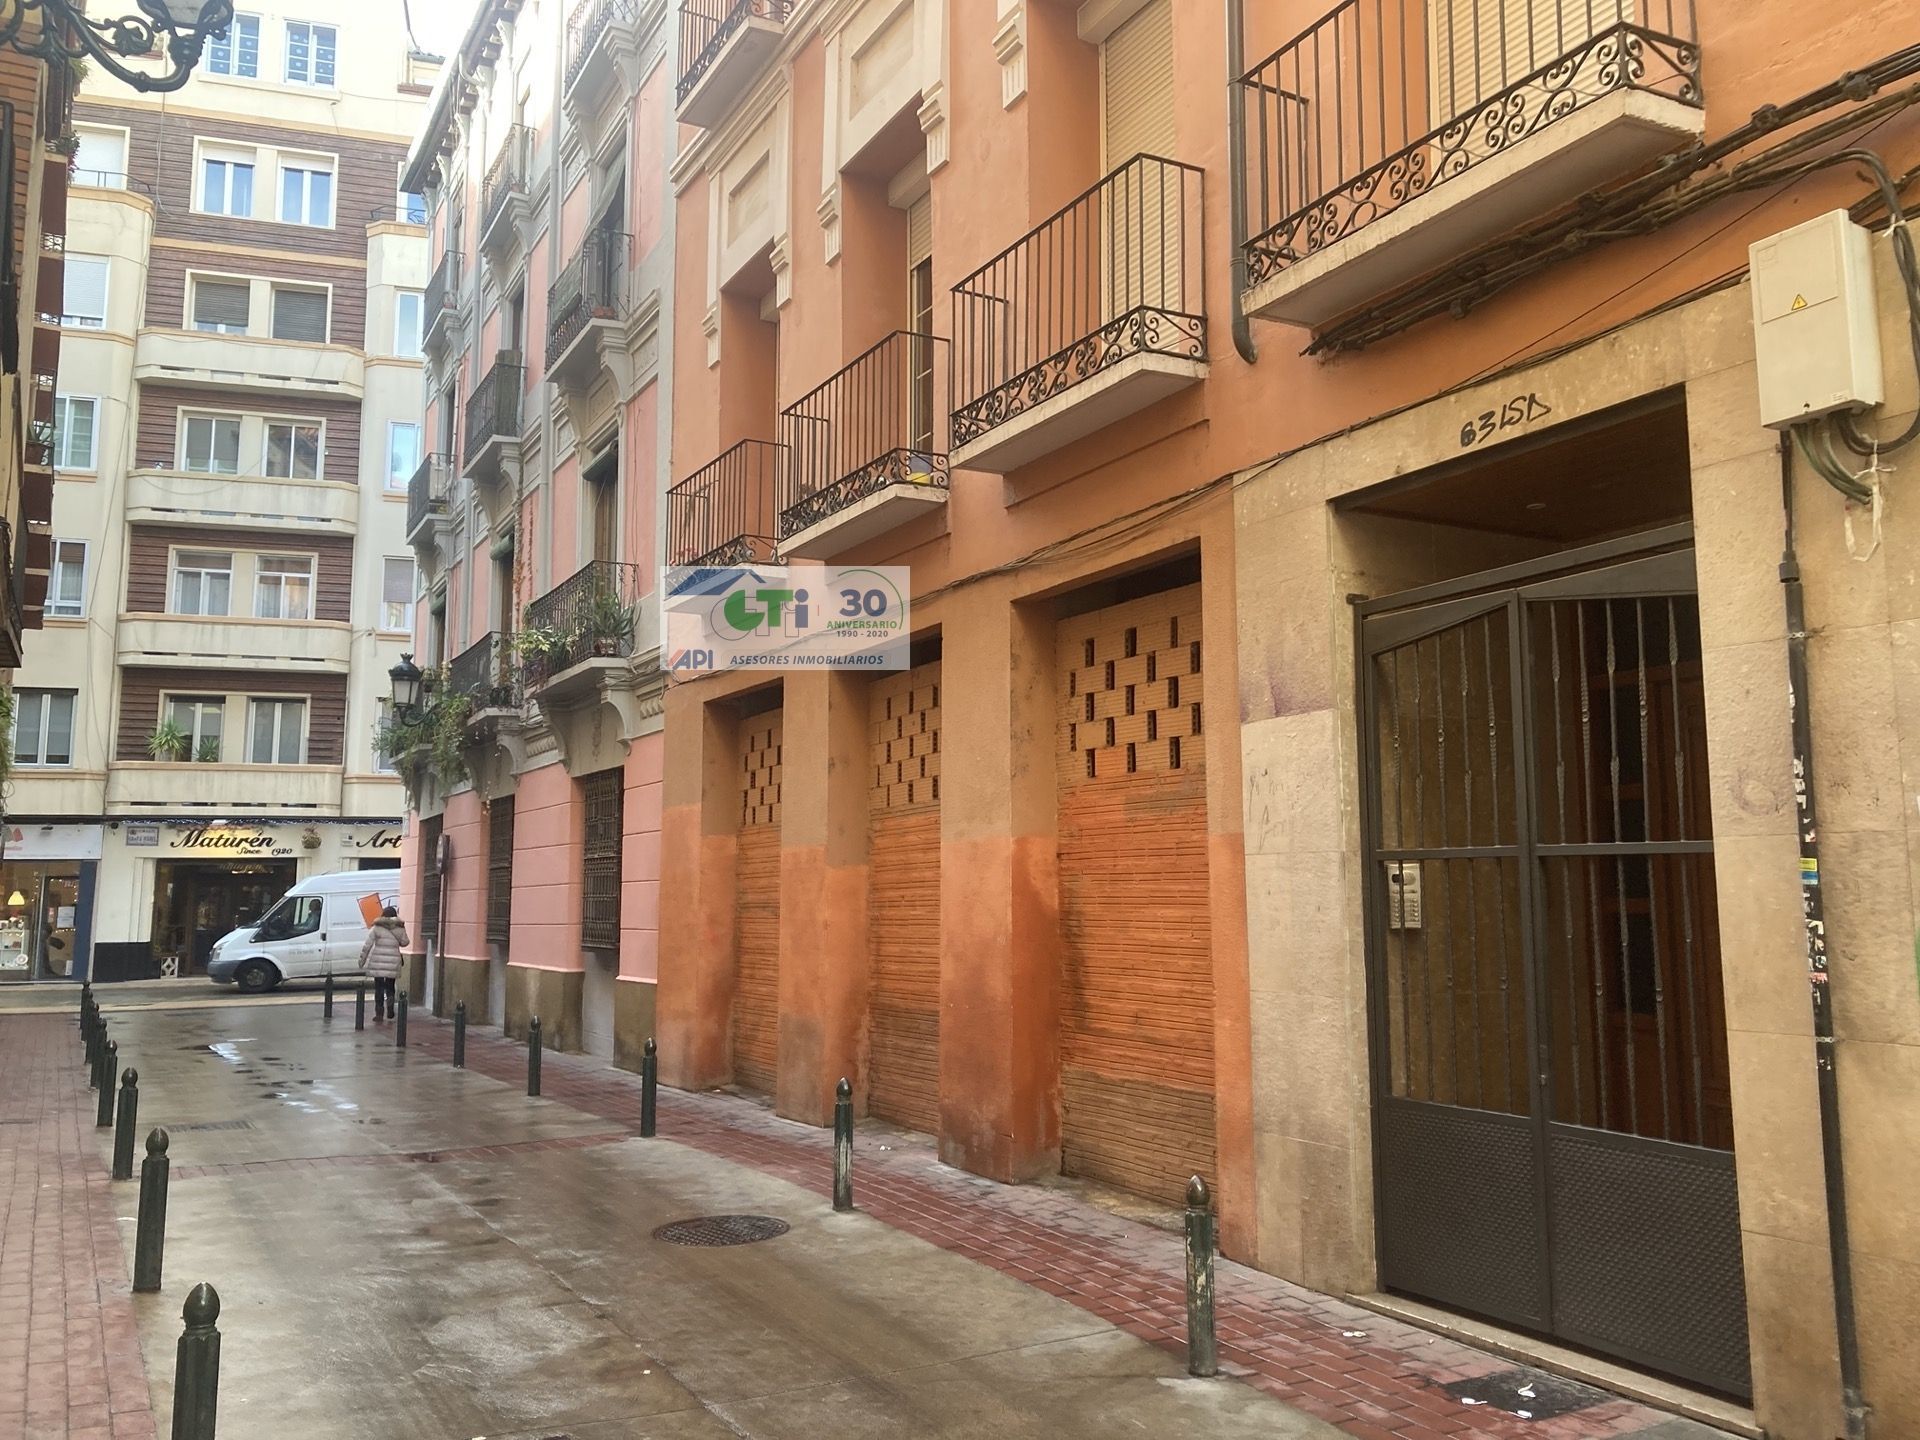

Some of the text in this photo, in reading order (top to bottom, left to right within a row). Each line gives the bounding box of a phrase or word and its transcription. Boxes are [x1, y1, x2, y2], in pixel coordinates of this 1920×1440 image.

[170, 829, 277, 848] Maturén
[236, 847, 293, 856] Since 1920
